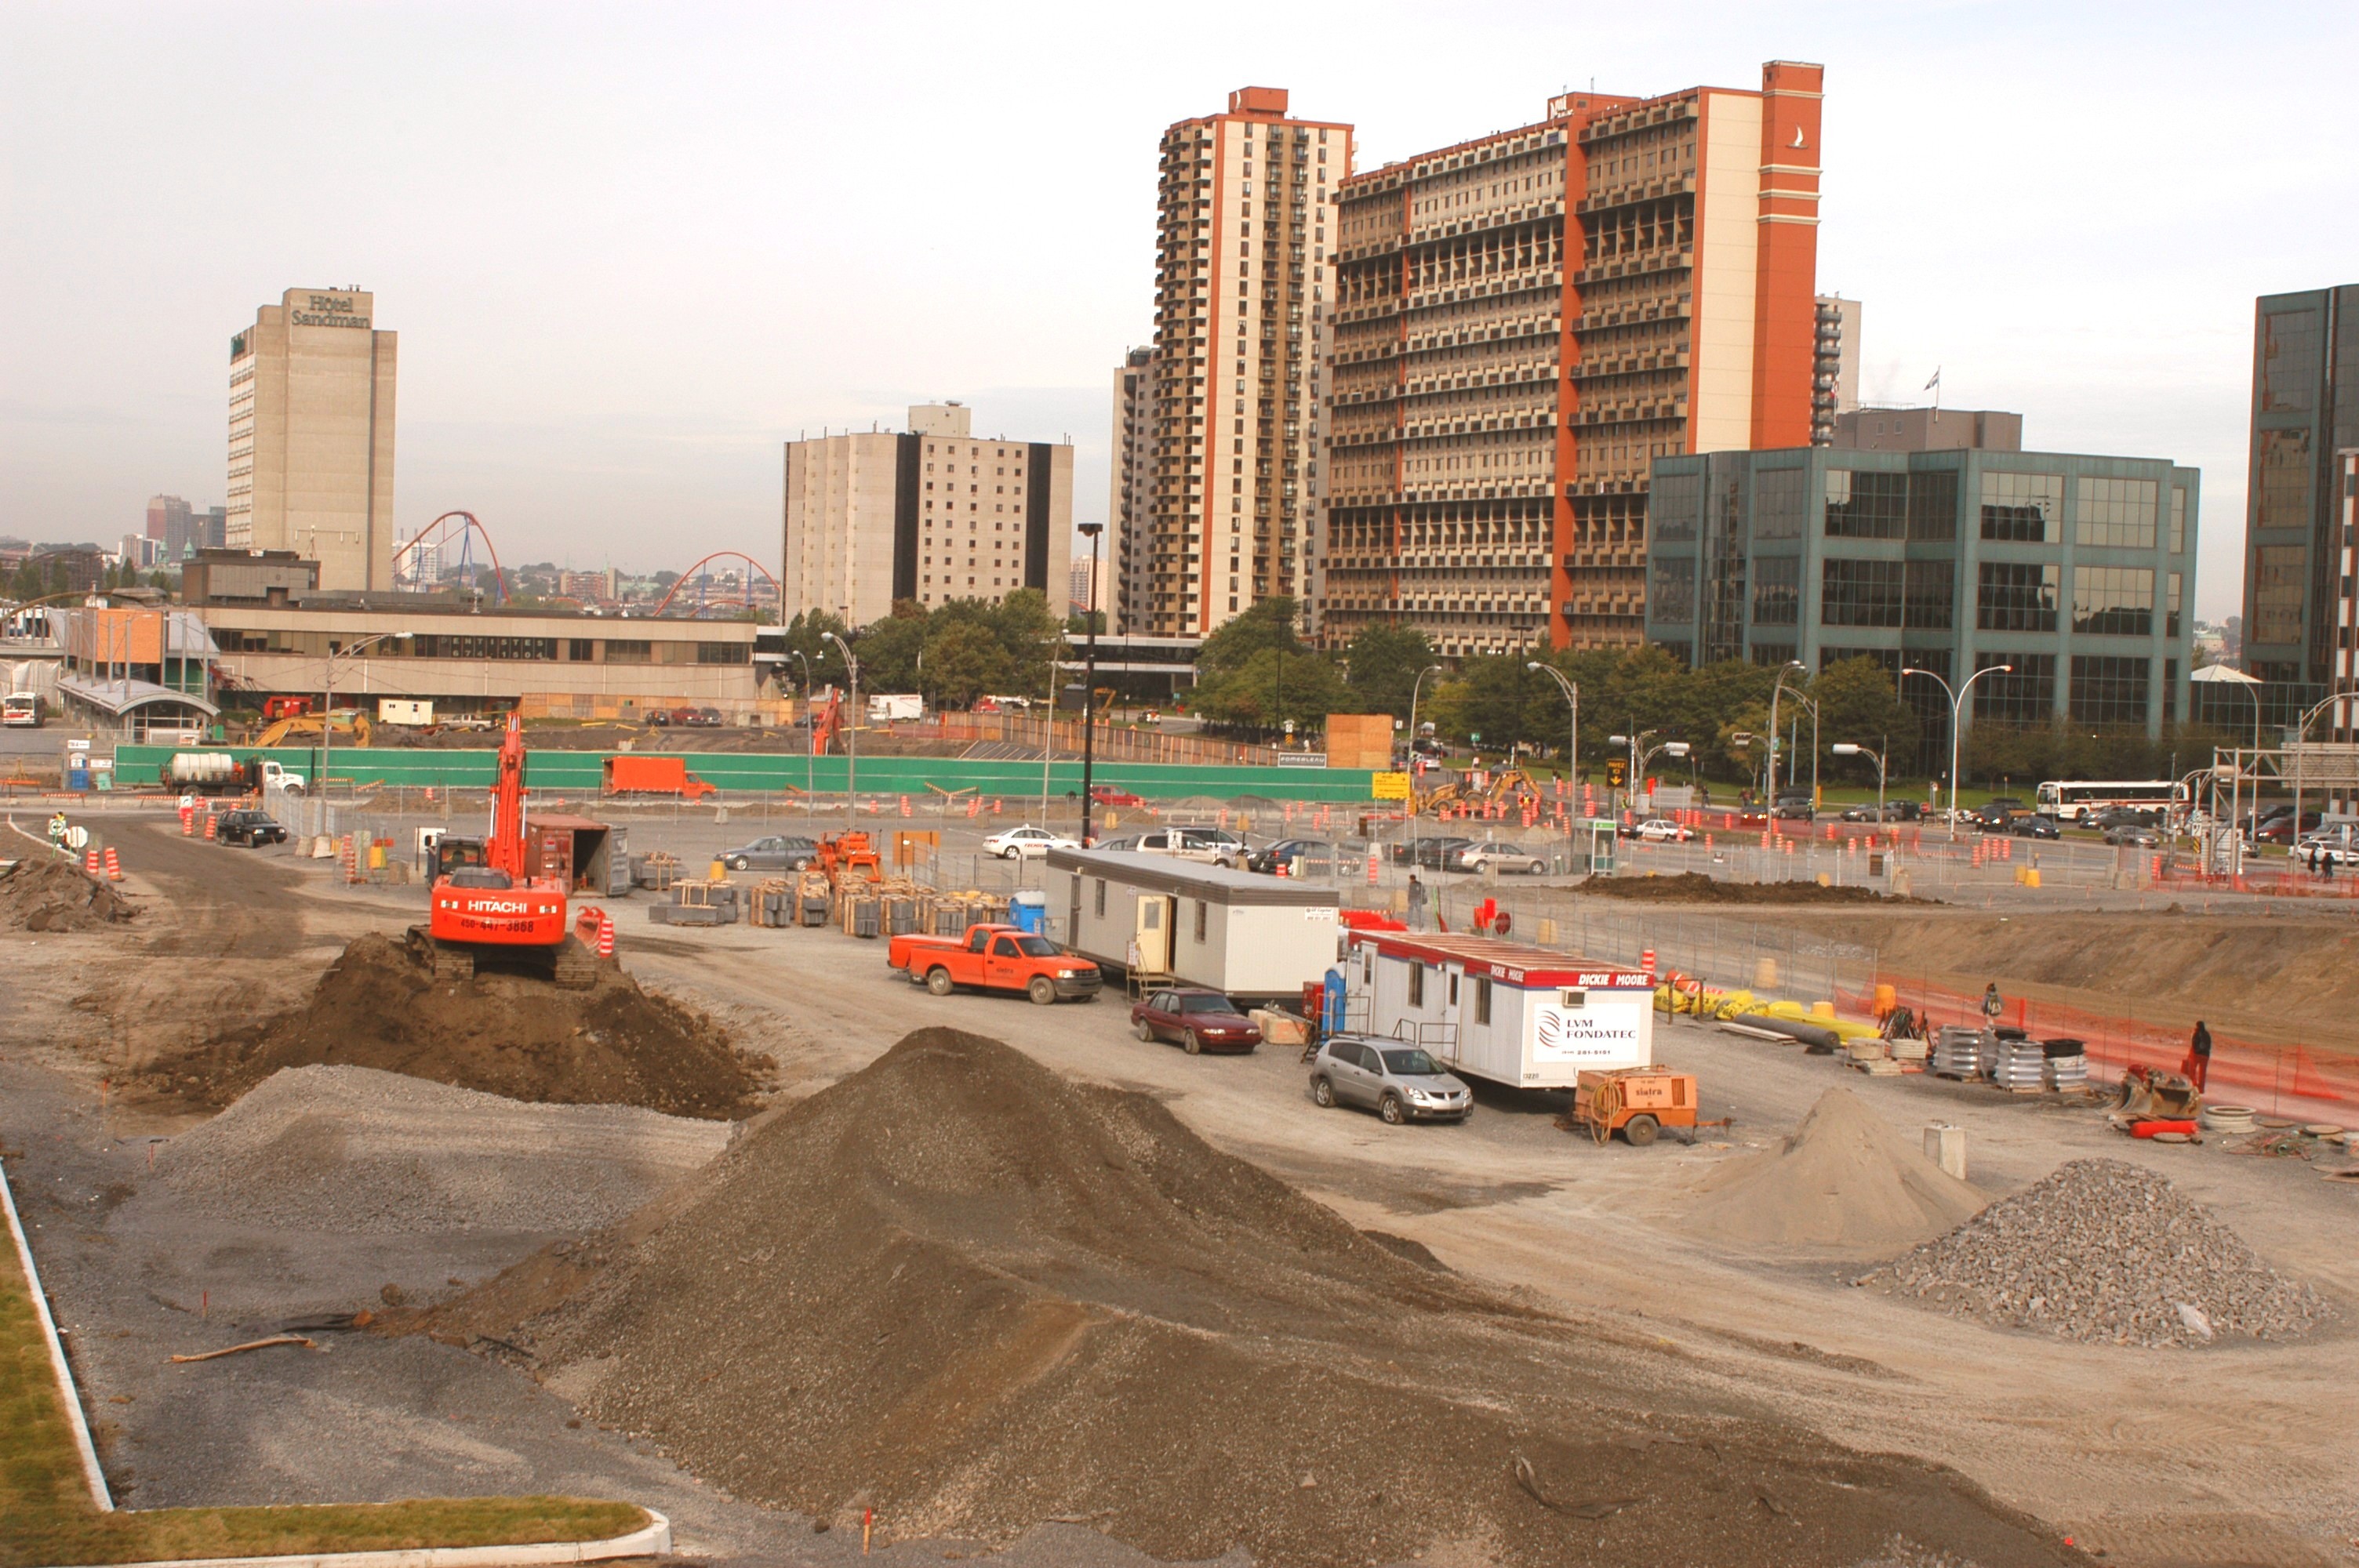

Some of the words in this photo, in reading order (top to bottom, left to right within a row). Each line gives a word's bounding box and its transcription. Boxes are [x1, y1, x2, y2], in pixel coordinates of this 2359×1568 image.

[309, 296, 353, 312] Hôtel
[292, 310, 371, 328] Sandman
[441, 637, 543, 647] DENTISTES
[468, 901, 527, 913] HITACHI
[1491, 964, 1506, 978] DICKIE
[1508, 969, 1524, 982] MOORE
[1579, 974, 1610, 985] DICKIE
[1616, 975, 1648, 986] MOORE
[1567, 1019, 1593, 1028] LVM
[1567, 1030, 1636, 1039] FONDATEC
